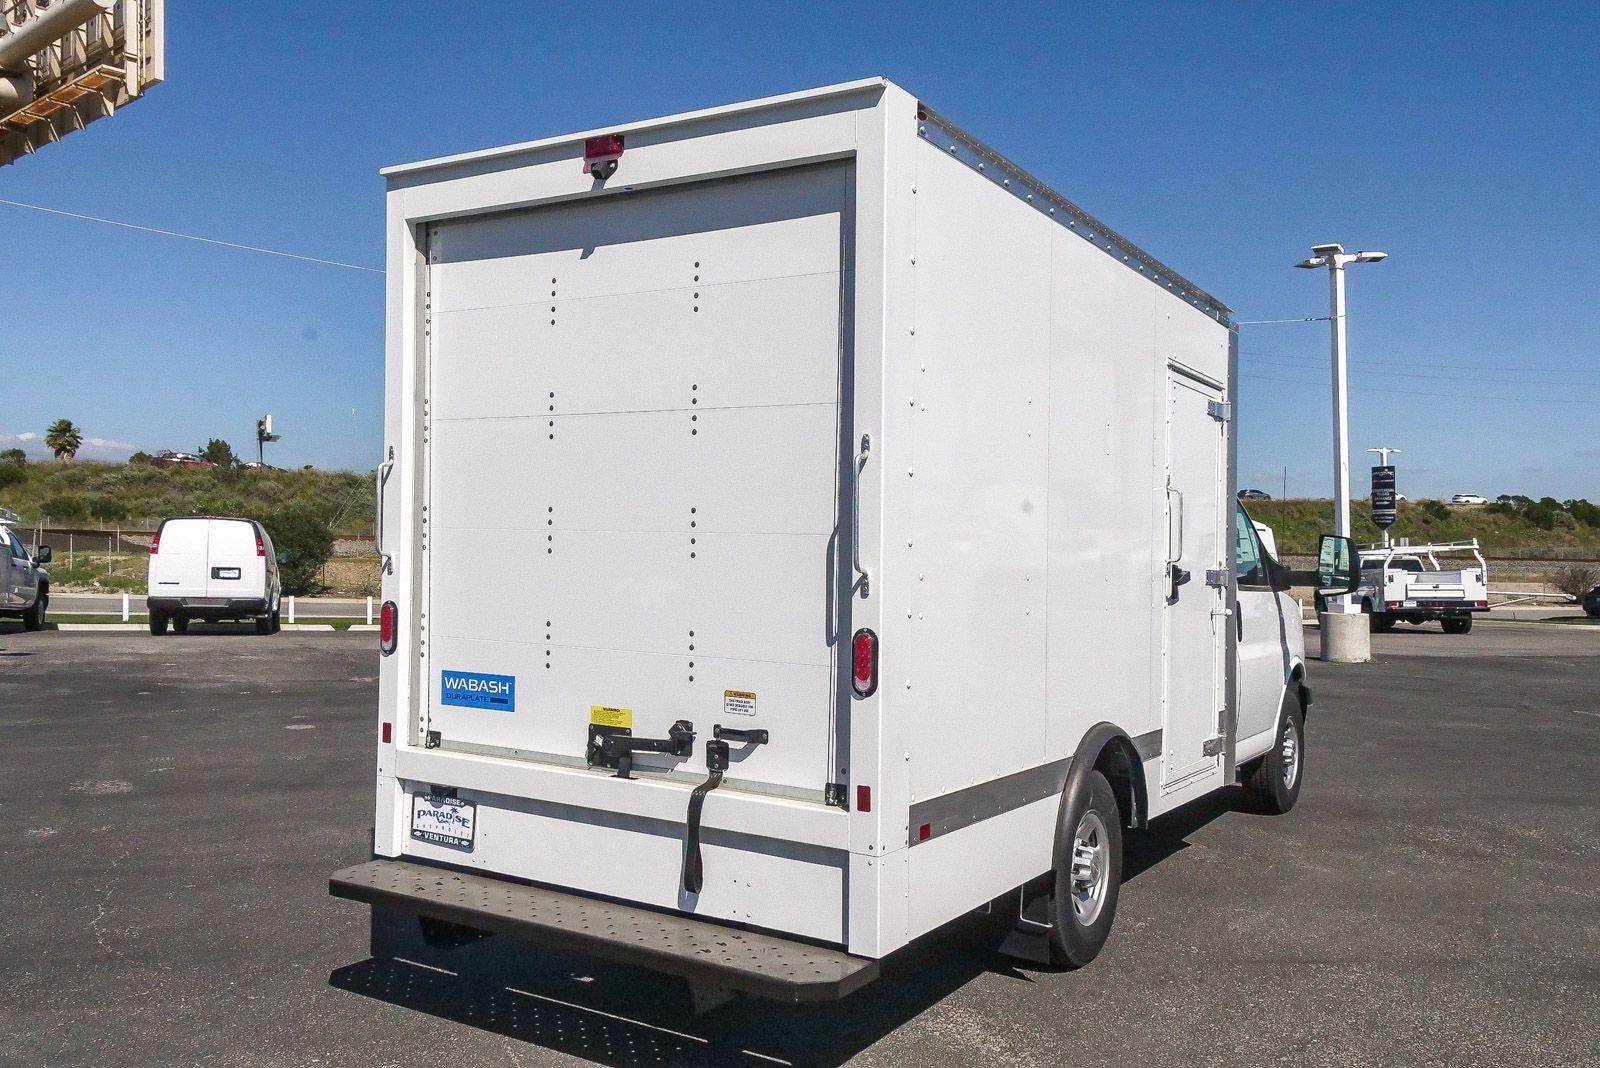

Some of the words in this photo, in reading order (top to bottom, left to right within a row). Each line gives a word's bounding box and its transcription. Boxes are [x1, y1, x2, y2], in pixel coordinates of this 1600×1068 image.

[444, 677, 510, 694] WABASH
[446, 693, 489, 702] DURAPLATE
[417, 809, 471, 829] PARADISE
[424, 831, 459, 845] VENTURA
